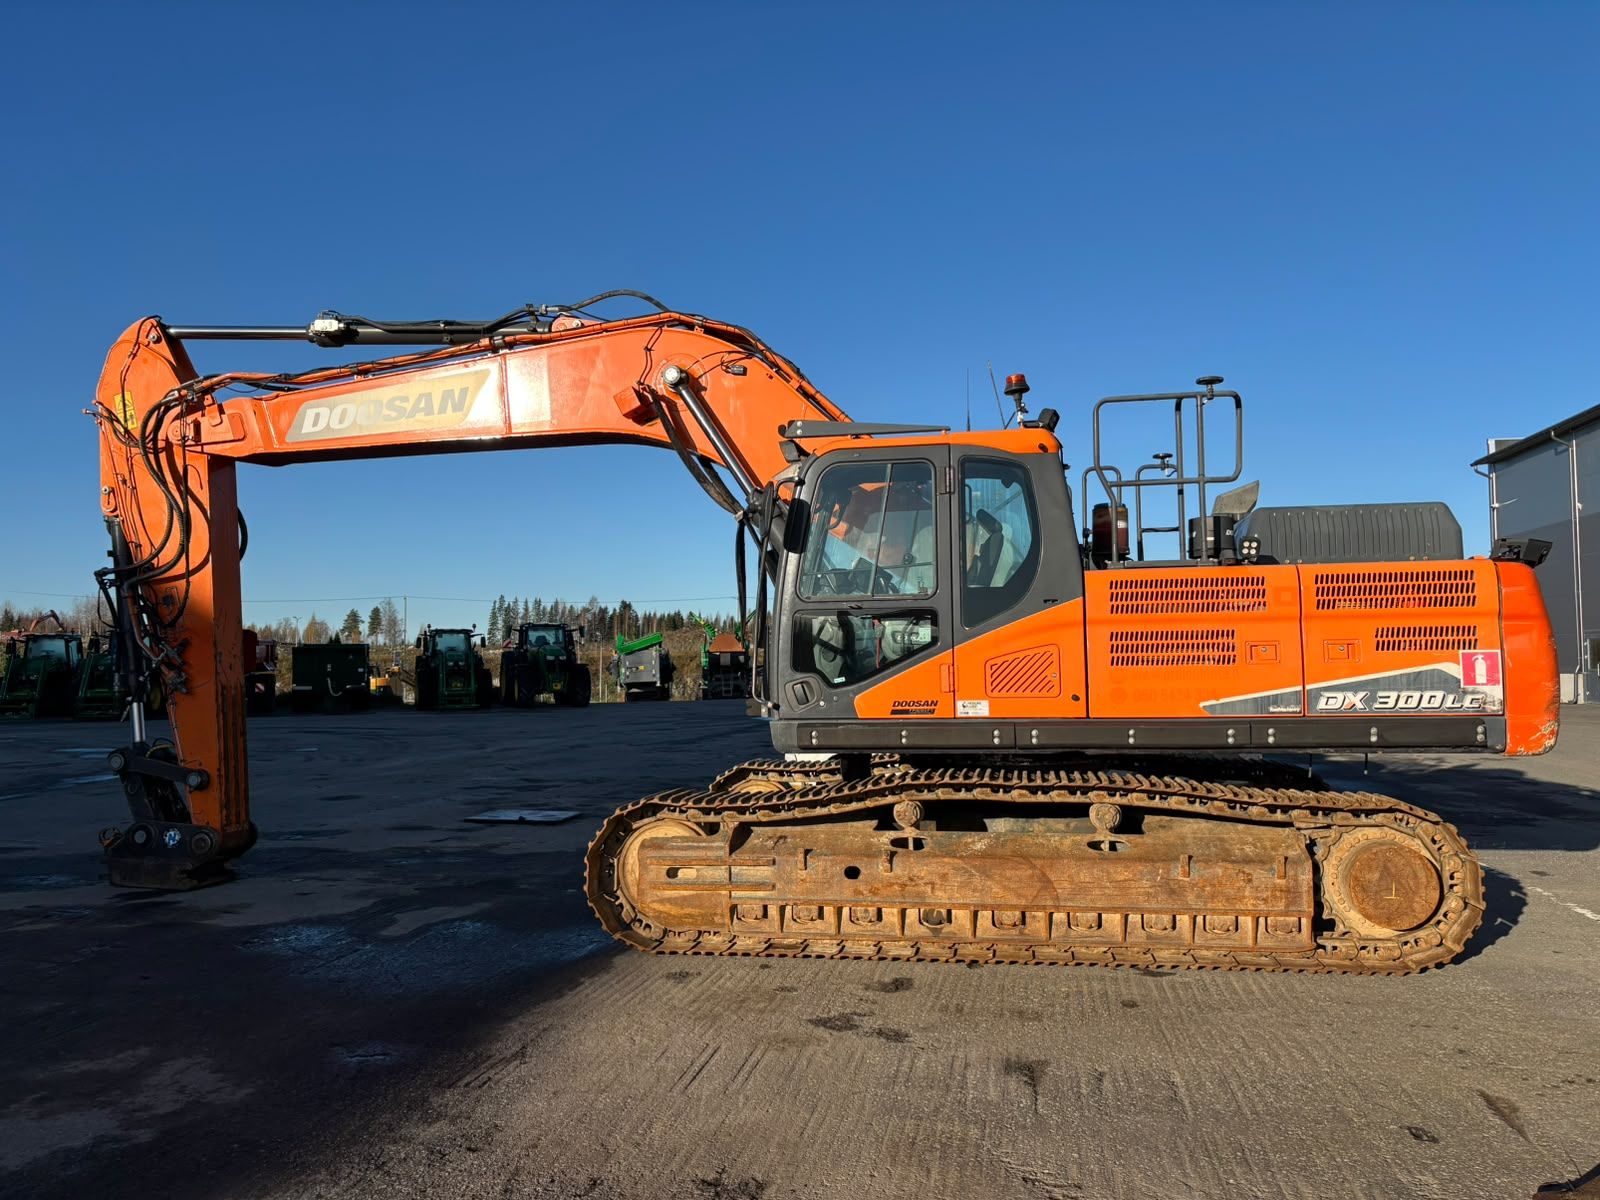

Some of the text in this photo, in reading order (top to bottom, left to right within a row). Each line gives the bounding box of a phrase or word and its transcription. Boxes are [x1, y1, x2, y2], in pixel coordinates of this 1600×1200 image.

[301, 386, 470, 434] DOOSAN
[892, 700, 939, 708] DOOSAN
[1317, 691, 1369, 711] DX
